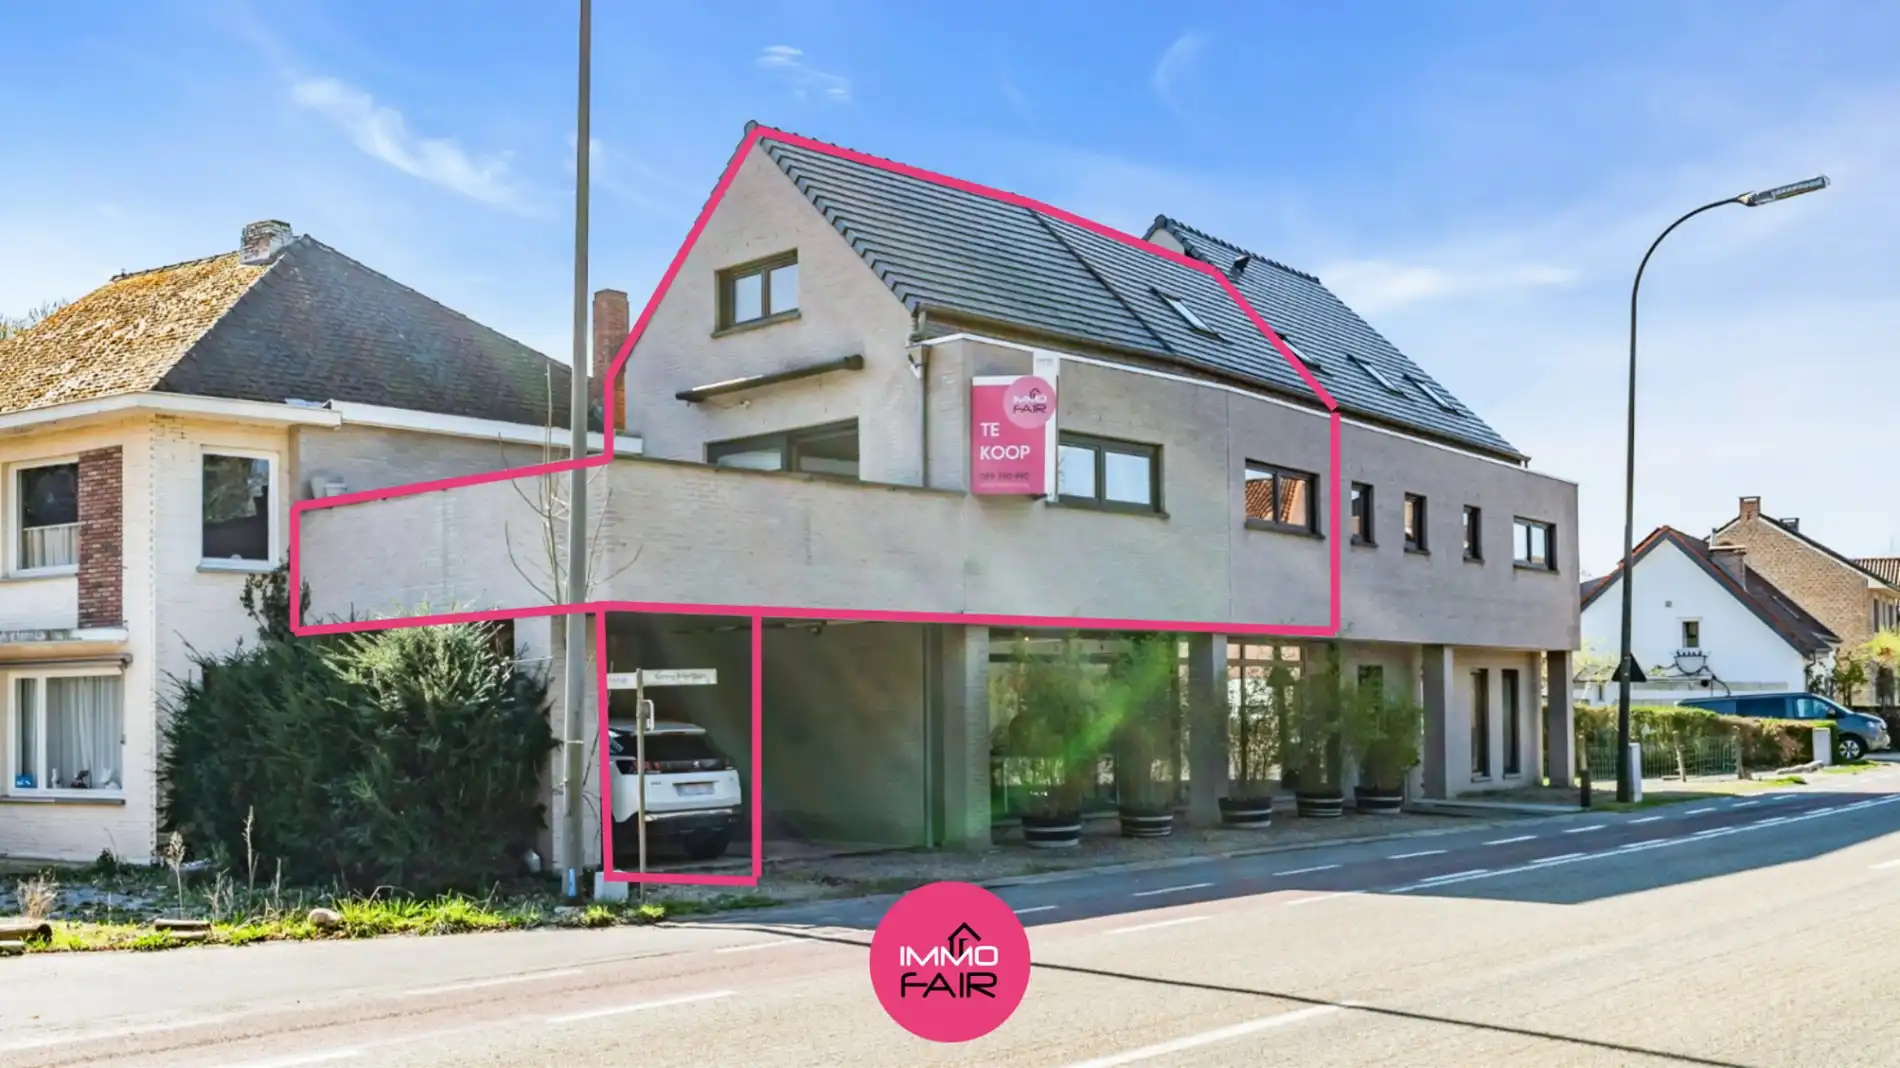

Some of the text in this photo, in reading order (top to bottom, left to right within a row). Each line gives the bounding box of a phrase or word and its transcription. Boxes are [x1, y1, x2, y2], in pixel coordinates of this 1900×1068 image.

[1013, 404, 1047, 413] FAIR
[980, 422, 1000, 437] TE
[980, 445, 1030, 460] KOOP
